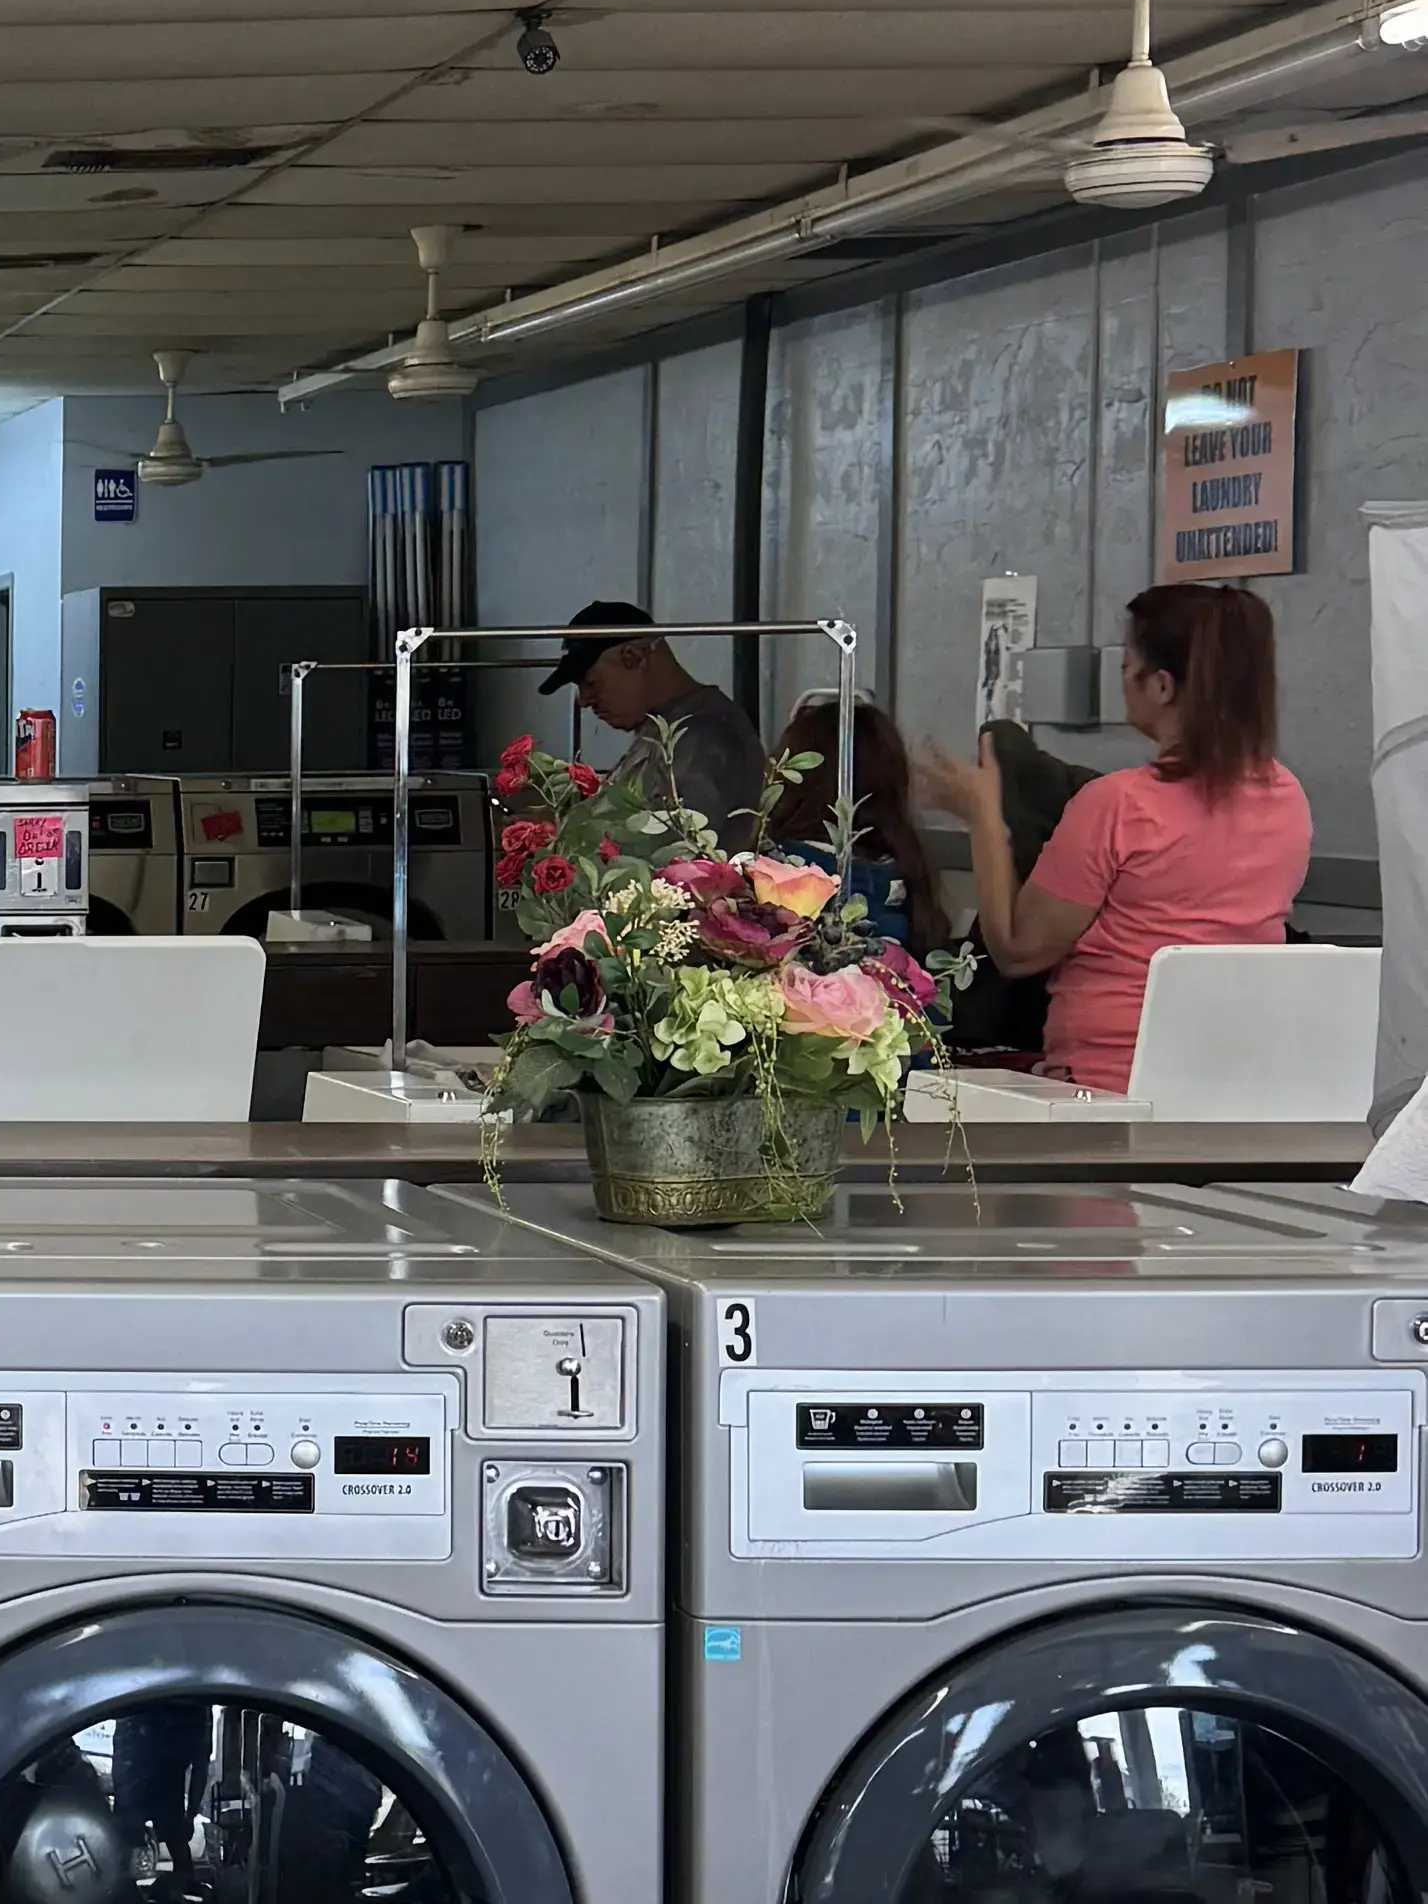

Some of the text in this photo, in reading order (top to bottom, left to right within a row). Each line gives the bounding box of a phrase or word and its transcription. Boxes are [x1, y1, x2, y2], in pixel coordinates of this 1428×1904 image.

[1225, 375, 1258, 408] NOT
[1184, 421, 1273, 468] LEAVE YOUR
[1192, 472, 1263, 514] LAUNDRY
[1175, 519, 1279, 564] UNATTENDED!
[189, 891, 209, 911] 27
[724, 1303, 753, 1362] 3
[392, 1447, 419, 1465] 14
[342, 1484, 412, 1496] CROSSOVER 2.0
[1311, 1481, 1382, 1493] CROSSOVER 2.0
